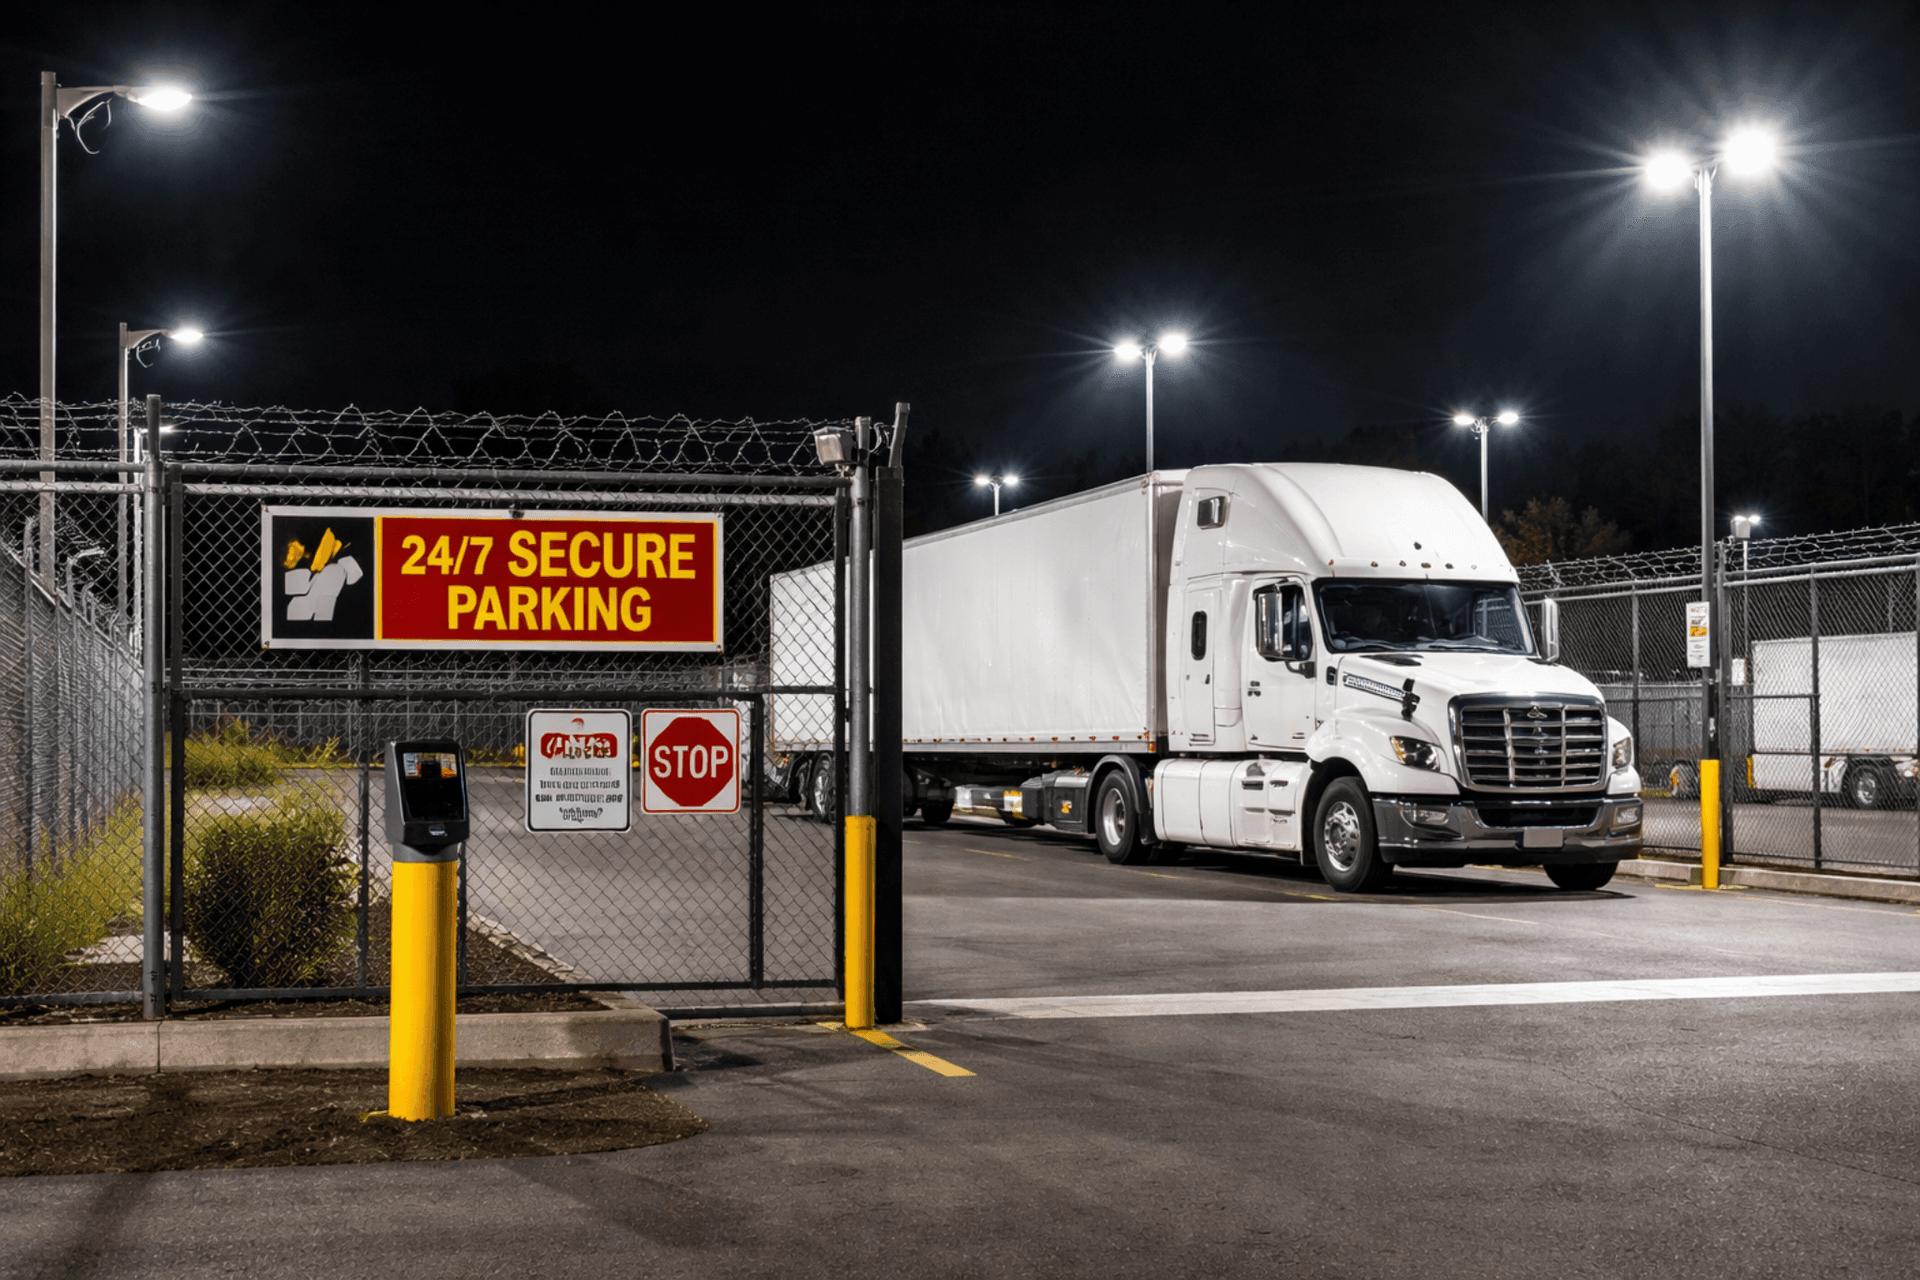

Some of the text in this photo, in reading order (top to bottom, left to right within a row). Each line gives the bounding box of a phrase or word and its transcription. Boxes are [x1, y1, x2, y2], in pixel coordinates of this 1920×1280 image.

[401, 530, 696, 580] 24/7 SECURE
[448, 585, 652, 632] PARKING
[653, 745, 729, 779] STOP
